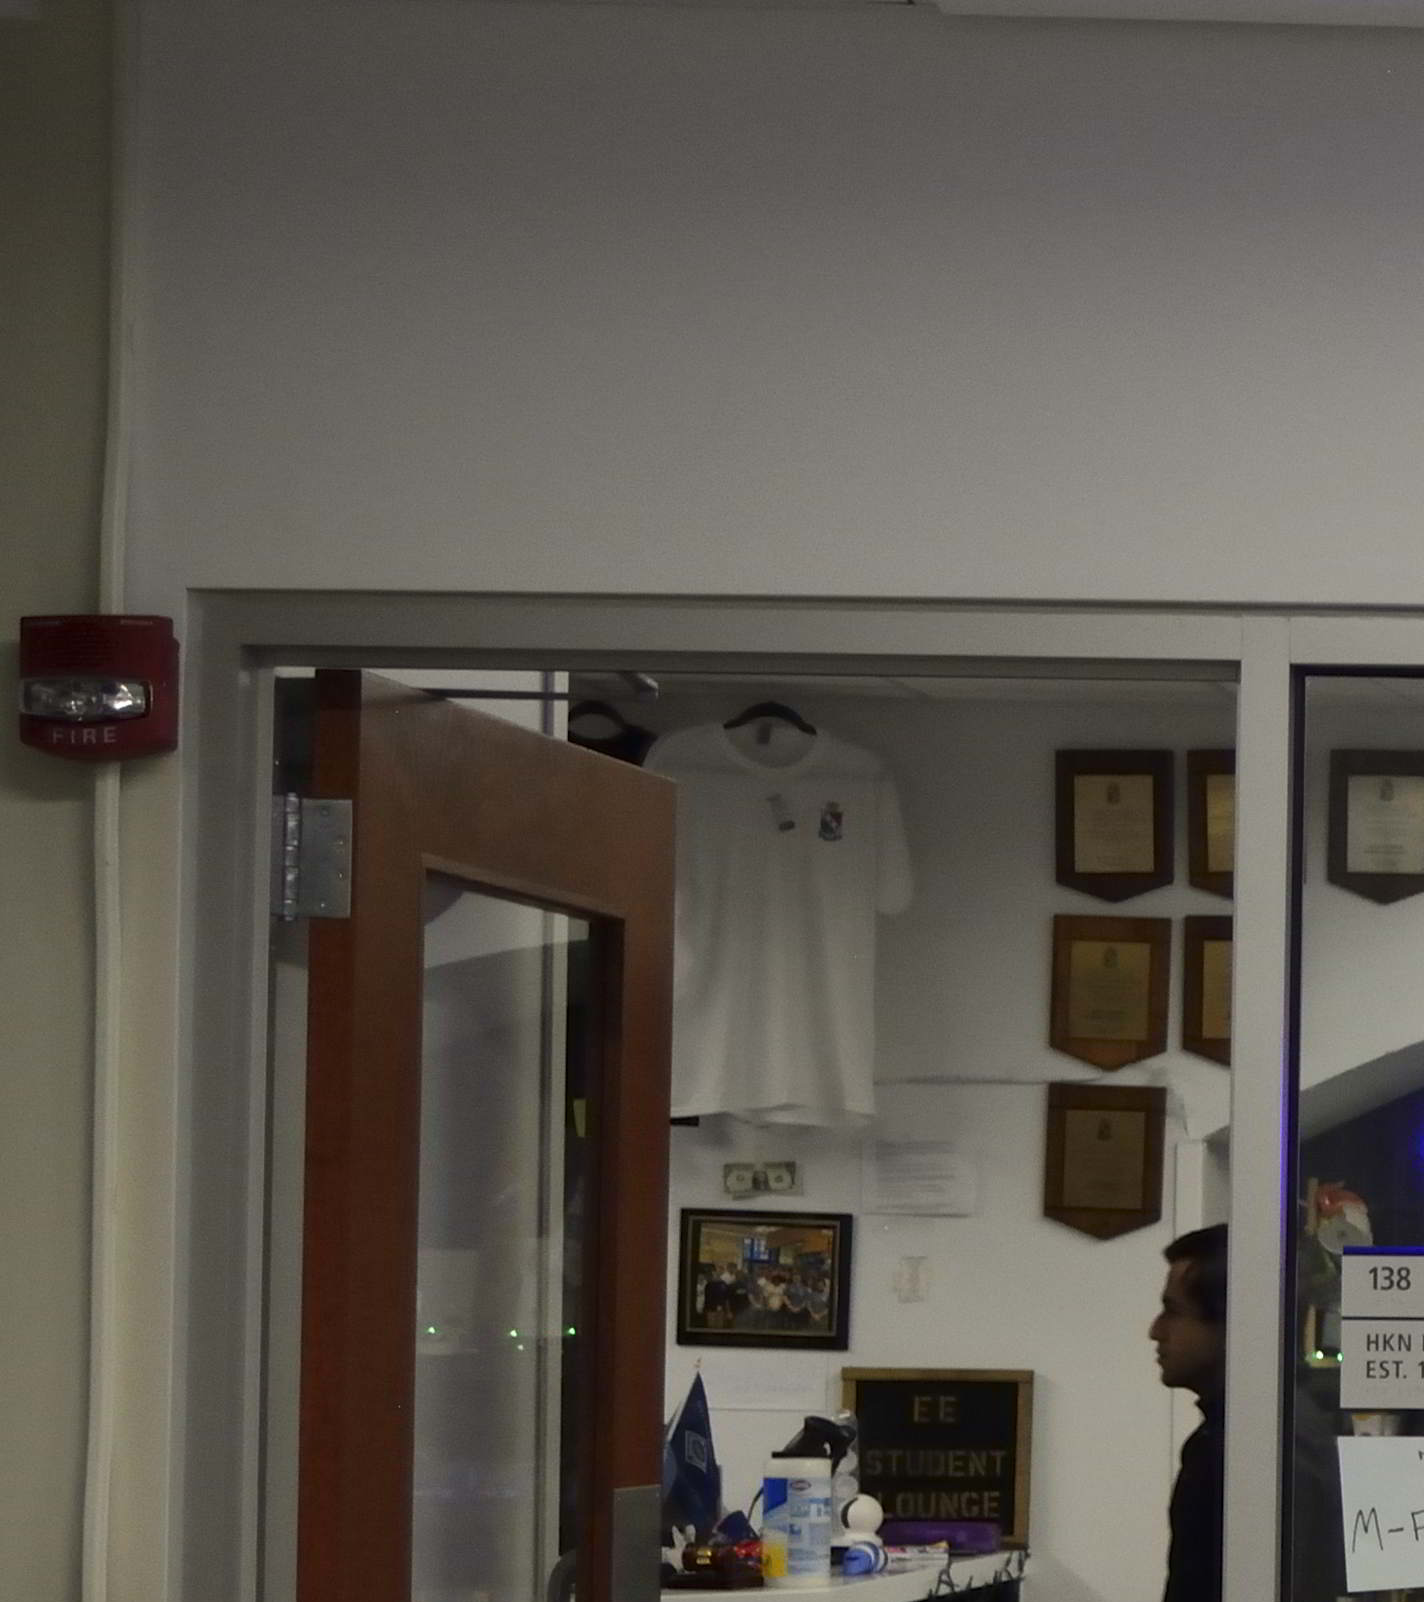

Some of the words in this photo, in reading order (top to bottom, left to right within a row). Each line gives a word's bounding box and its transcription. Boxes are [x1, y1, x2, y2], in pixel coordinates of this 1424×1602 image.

[52, 726, 118, 745] FIRE
[1368, 1266, 1412, 1291] 138
[1366, 1333, 1413, 1353] HKN
[1366, 1360, 1408, 1380] EST.
[913, 1396, 957, 1423] EE
[865, 1449, 1007, 1478] STUDENT
